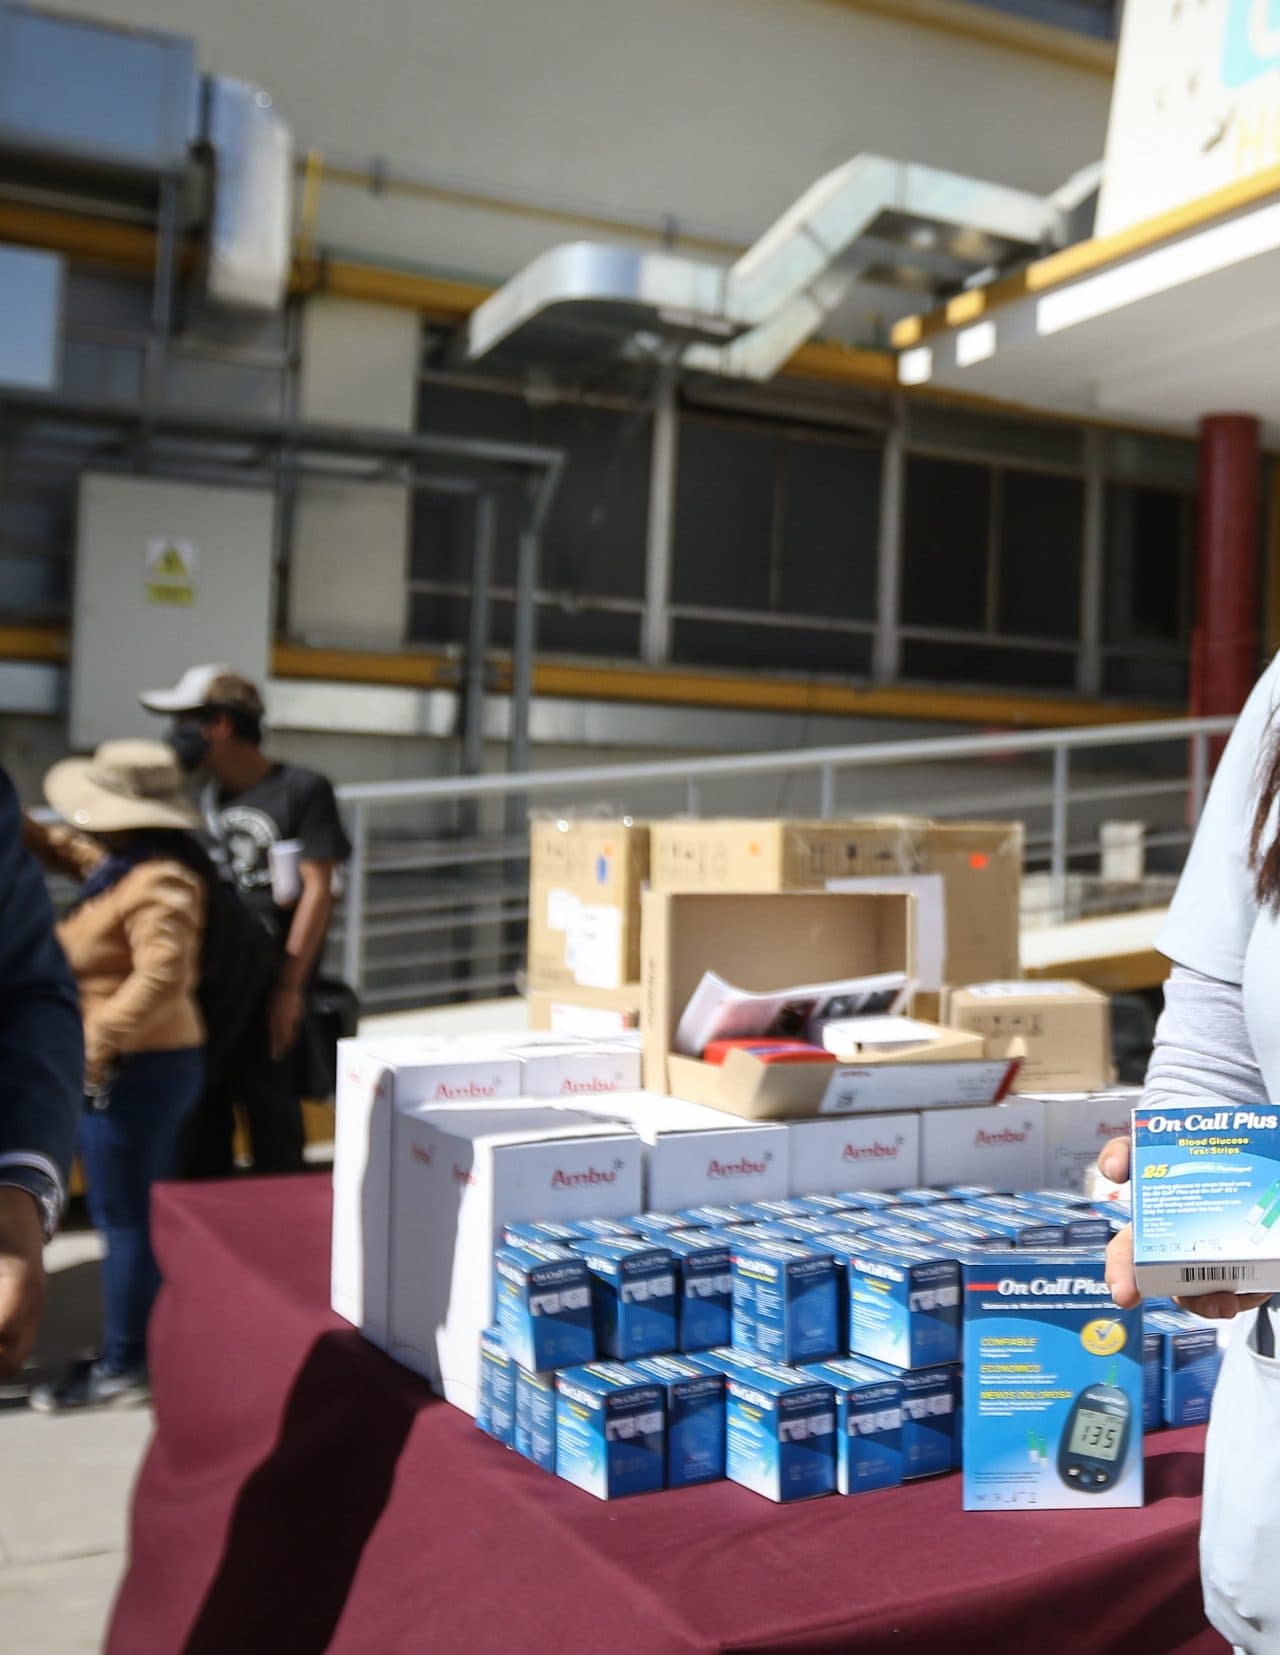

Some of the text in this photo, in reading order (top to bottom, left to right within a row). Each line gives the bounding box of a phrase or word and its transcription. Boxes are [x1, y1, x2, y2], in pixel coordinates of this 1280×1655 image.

[436, 1080, 494, 1099] Ambu
[562, 1077, 618, 1093] Ambu
[1148, 1112, 1278, 1133] On Call Plus
[975, 1128, 1027, 1146] Ambu
[1178, 1137, 1249, 1147] Blood Glucose
[842, 1141, 897, 1160] Ambu
[1188, 1147, 1240, 1156] Test Strips
[707, 1157, 767, 1177] Ambu
[552, 1167, 616, 1187] Ambu
[998, 1278, 1112, 1296] On Call Plus
[1082, 1425, 1116, 1449] 135
